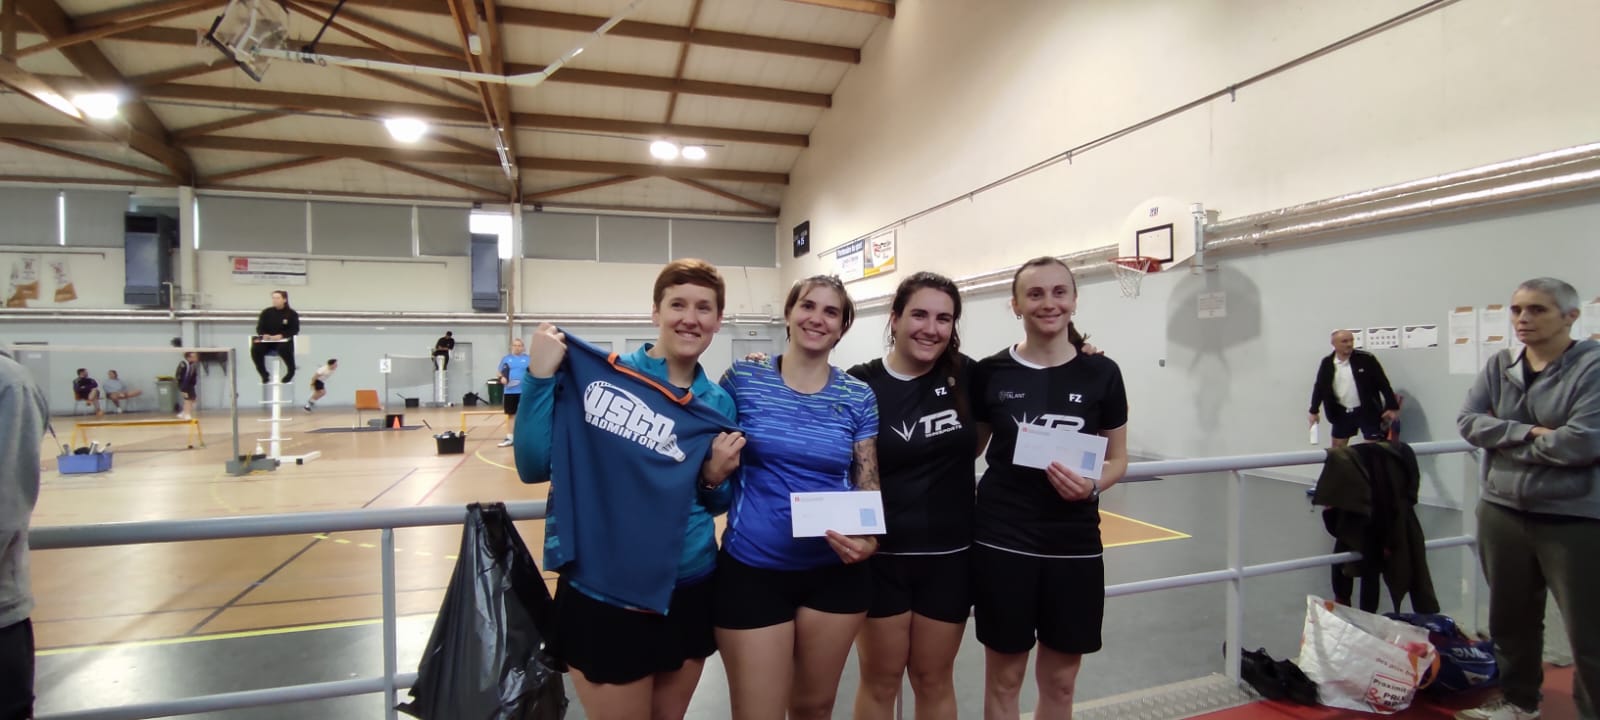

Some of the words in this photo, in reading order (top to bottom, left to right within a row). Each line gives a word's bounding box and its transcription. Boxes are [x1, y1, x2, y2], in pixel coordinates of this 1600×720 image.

[934, 386, 948, 397] FZ
[1068, 393, 1083, 403] FZ
[918, 408, 961, 434] TR
[585, 412, 657, 450] BADMINTON
